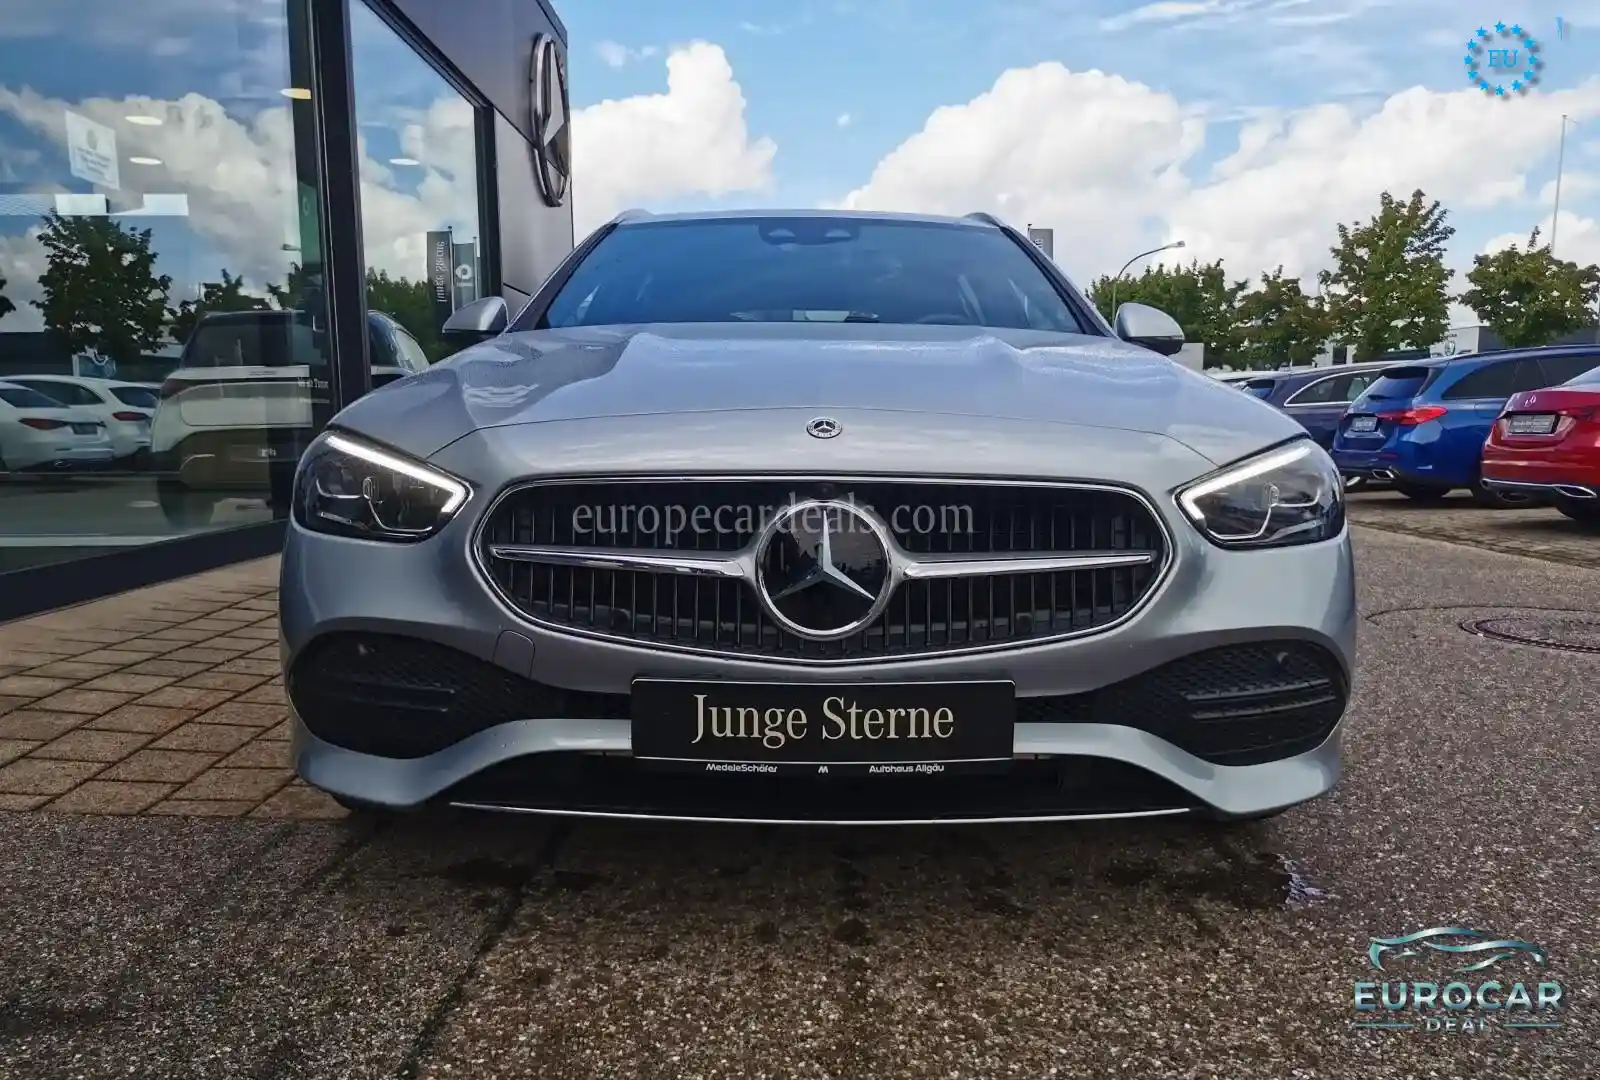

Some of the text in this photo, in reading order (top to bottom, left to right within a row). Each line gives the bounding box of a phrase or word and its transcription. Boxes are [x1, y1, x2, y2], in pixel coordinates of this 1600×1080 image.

[690, 694, 955, 749] Junge Sterne
[706, 762, 778, 774] MedeleSchäfer
[868, 762, 945, 775] Autohaus Allgäu
